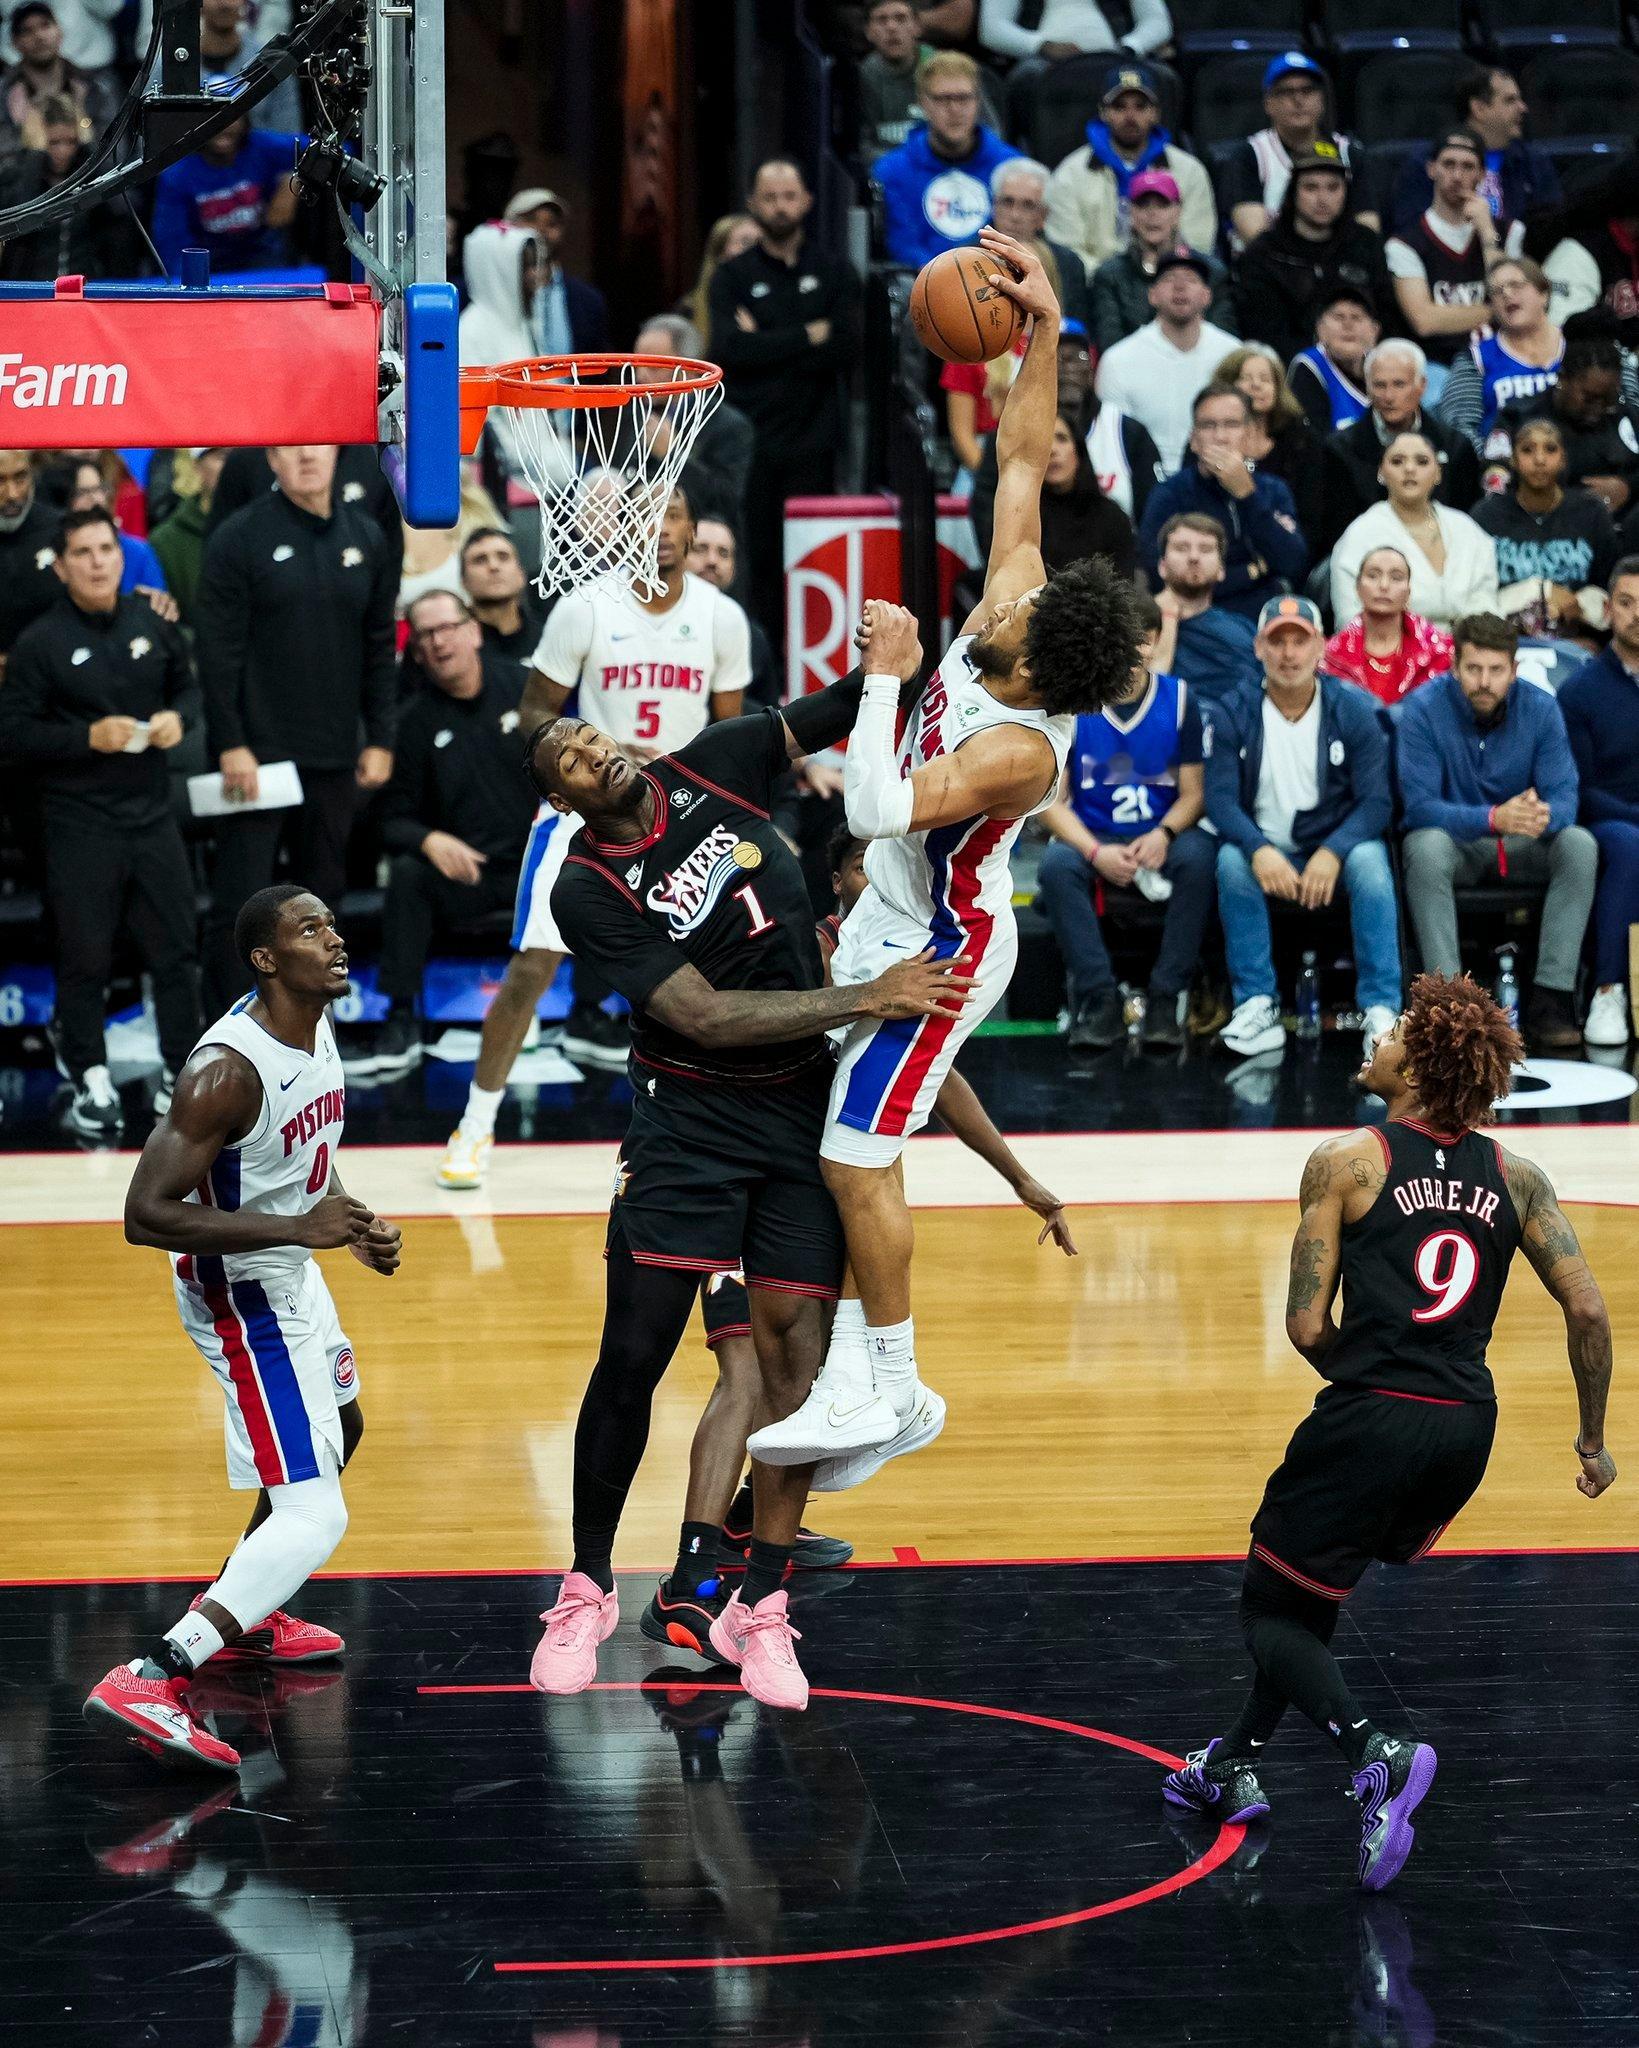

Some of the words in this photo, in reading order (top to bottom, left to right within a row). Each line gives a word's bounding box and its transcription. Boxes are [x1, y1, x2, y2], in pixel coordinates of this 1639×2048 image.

[0, 352, 128, 409] Farm
[600, 662, 704, 694] PISTONS
[635, 701, 661, 739] 5
[953, 702, 967, 729] StockX
[679, 793, 709, 820] crypto.com
[1111, 784, 1154, 824] 21
[624, 863, 641, 885] NIKE
[732, 882, 776, 938] 1
[306, 1141, 329, 1195] 0
[1393, 1177, 1463, 1216] OUBRE
[1465, 1186, 1500, 1228] JR.
[1411, 1229, 1480, 1323] 9
